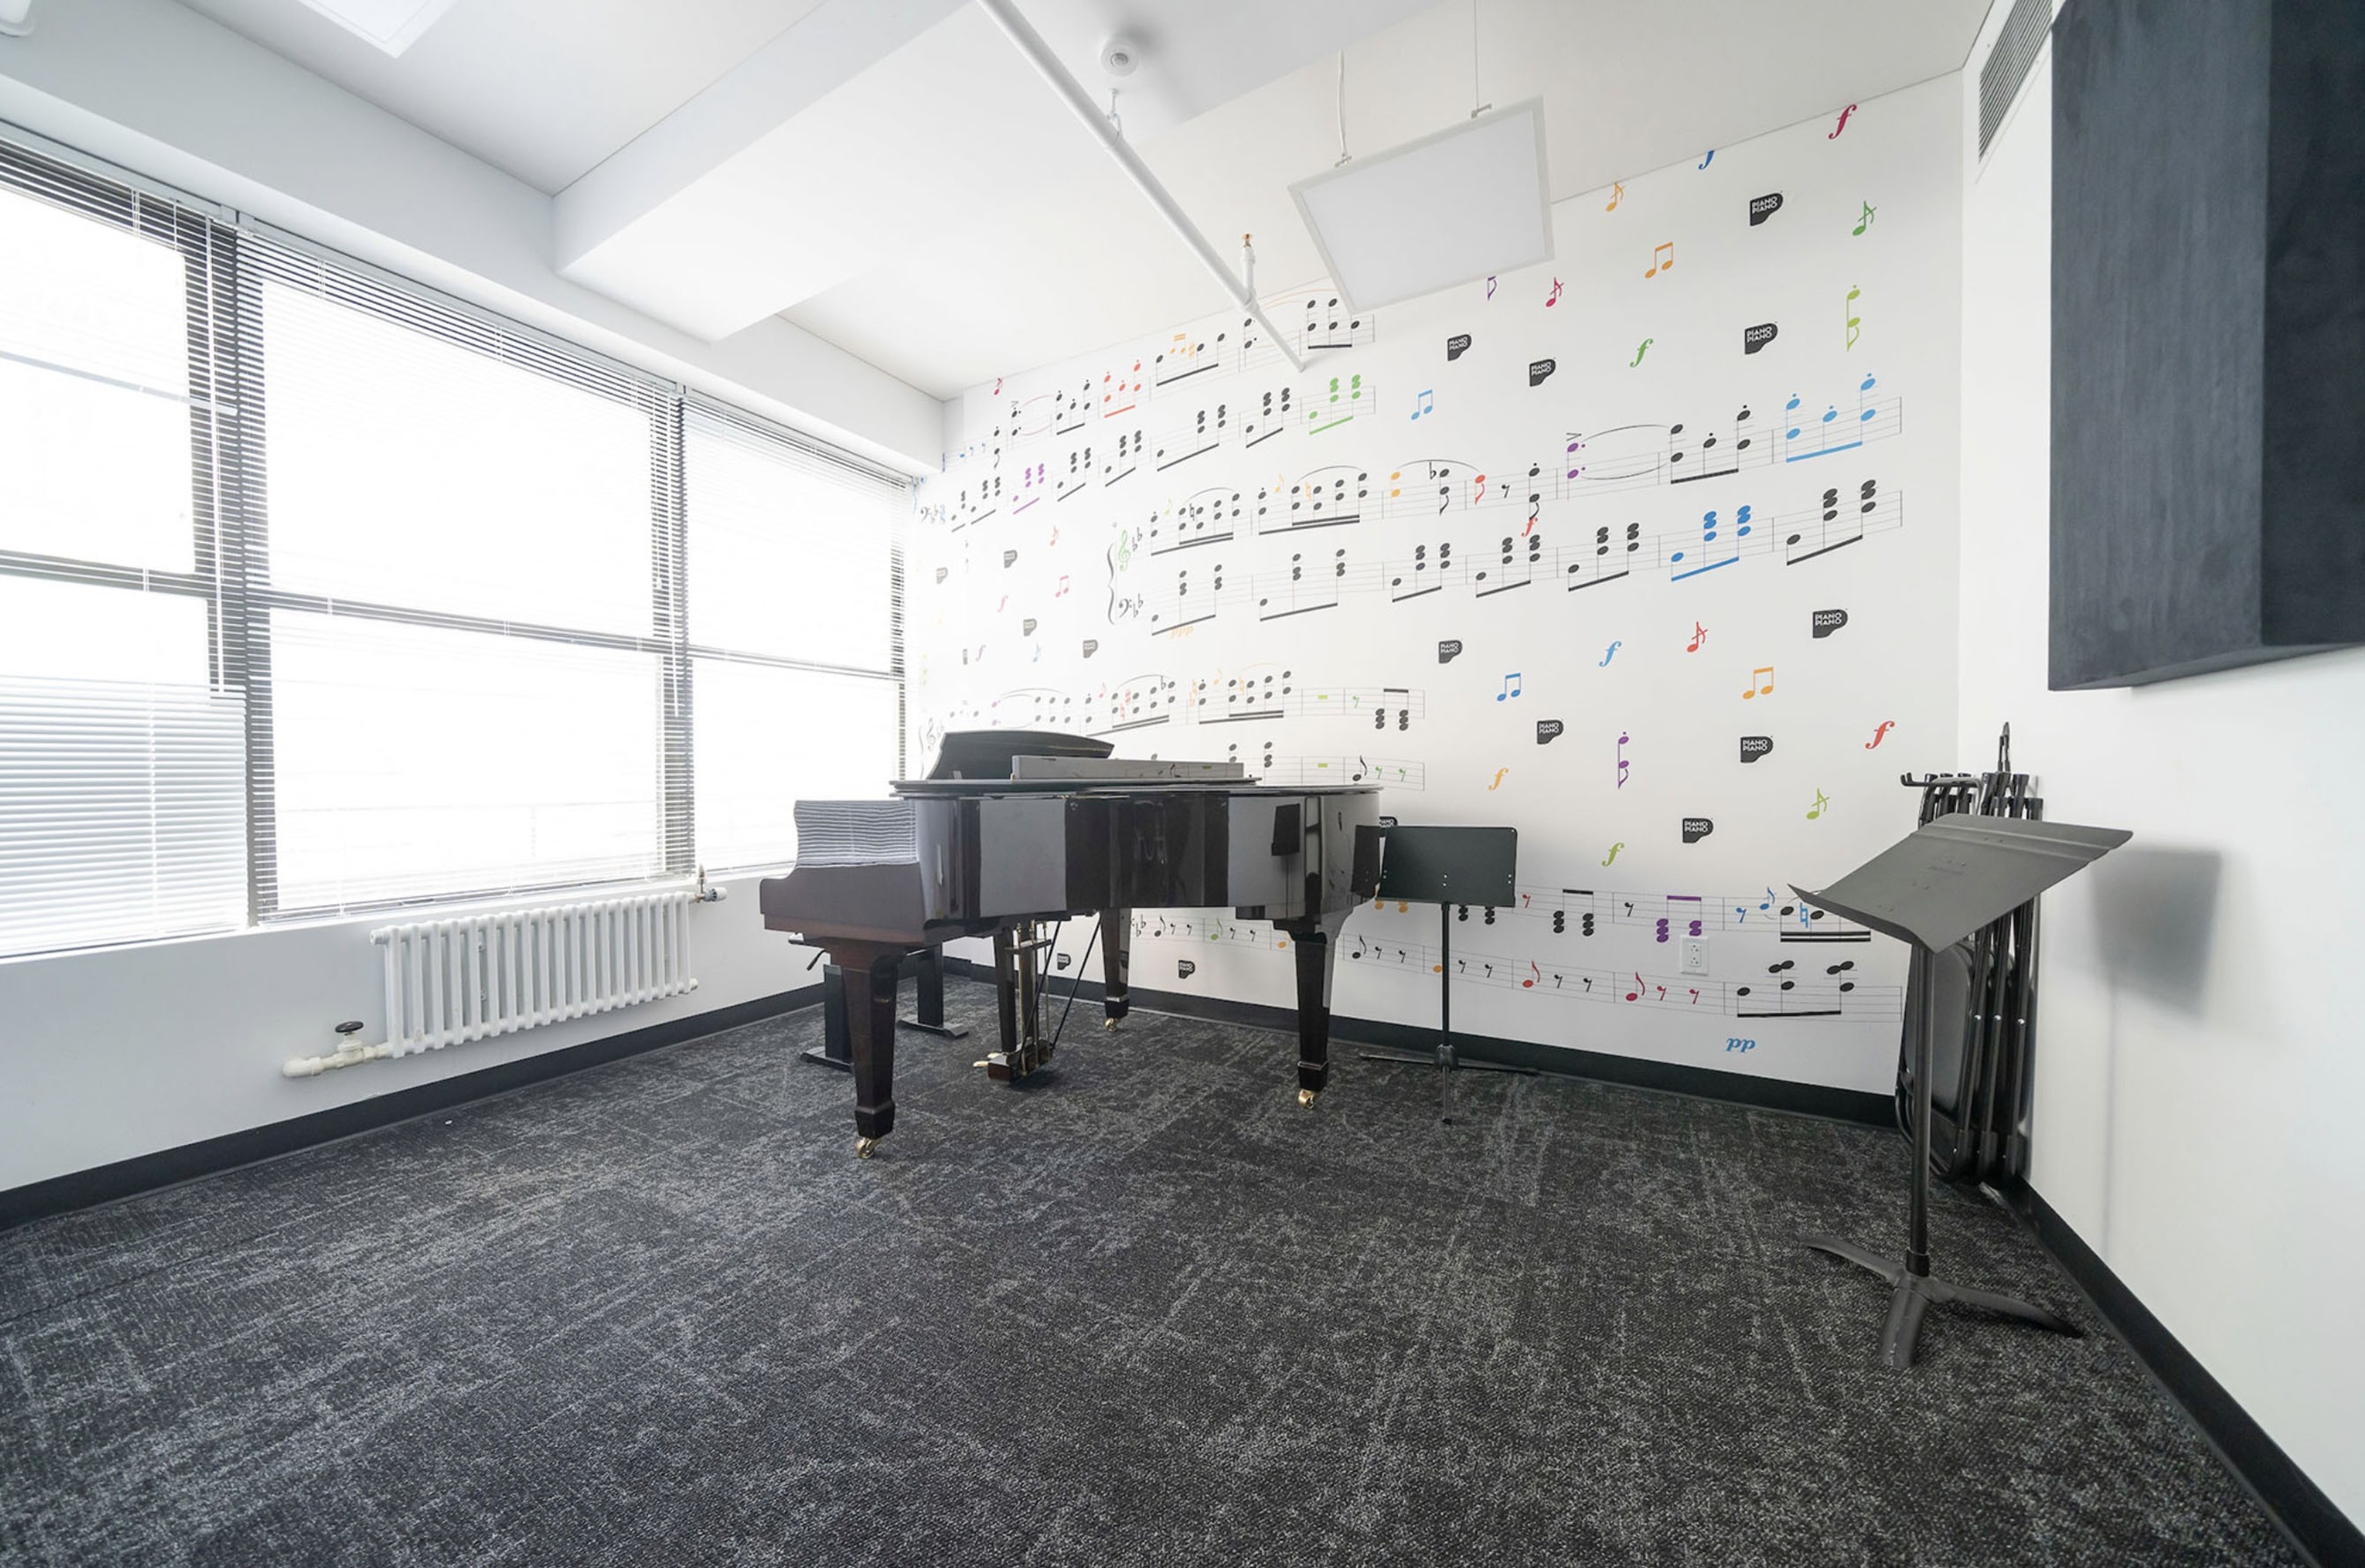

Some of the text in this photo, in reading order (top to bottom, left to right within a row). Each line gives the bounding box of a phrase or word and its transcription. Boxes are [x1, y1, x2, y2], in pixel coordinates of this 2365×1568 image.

[1752, 196, 1777, 209] PIANO
[1752, 201, 1777, 214] PIANO
[1747, 326, 1772, 337] PIANO
[1747, 332, 1772, 342] PIANO
[1814, 612, 1841, 620] PIANO
